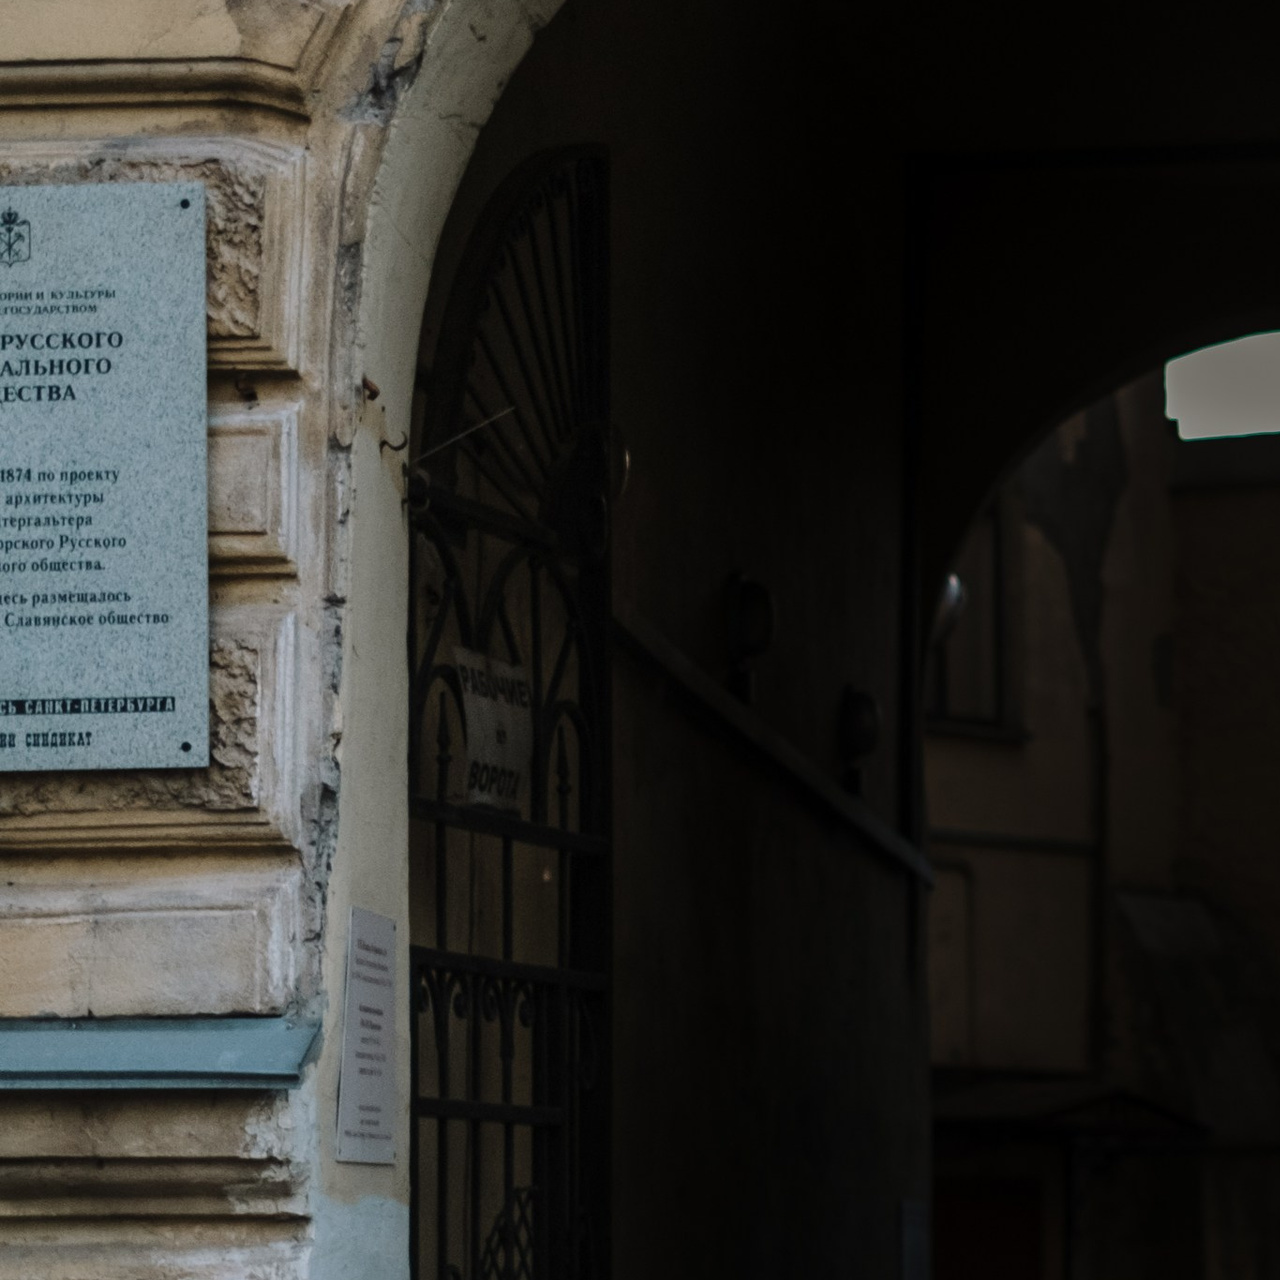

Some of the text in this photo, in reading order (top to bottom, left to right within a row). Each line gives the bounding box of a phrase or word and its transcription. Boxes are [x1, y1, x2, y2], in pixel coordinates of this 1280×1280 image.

[36, 291, 44, 300] И
[51, 289, 116, 300] КУЛЬТУРЫ
[3, 304, 97, 315] ГОСУДАРСТВОМ
[0, 331, 124, 351] РУССКОГО
[0, 357, 112, 377] АЛЬНОГО
[0, 384, 77, 404] ЕСТВА
[0, 468, 120, 486] 1874 по проекту
[5, 493, 104, 509] архитектуры
[0, 516, 93, 531] тергальтера
[59, 534, 127, 552] Русского
[0, 557, 105, 573] ого общества.
[0, 591, 132, 608] есь размещалось
[4, 611, 170, 629] Славянское общество
[25, 698, 174, 714] САНКТ-ПЕТЕРБУРГА
